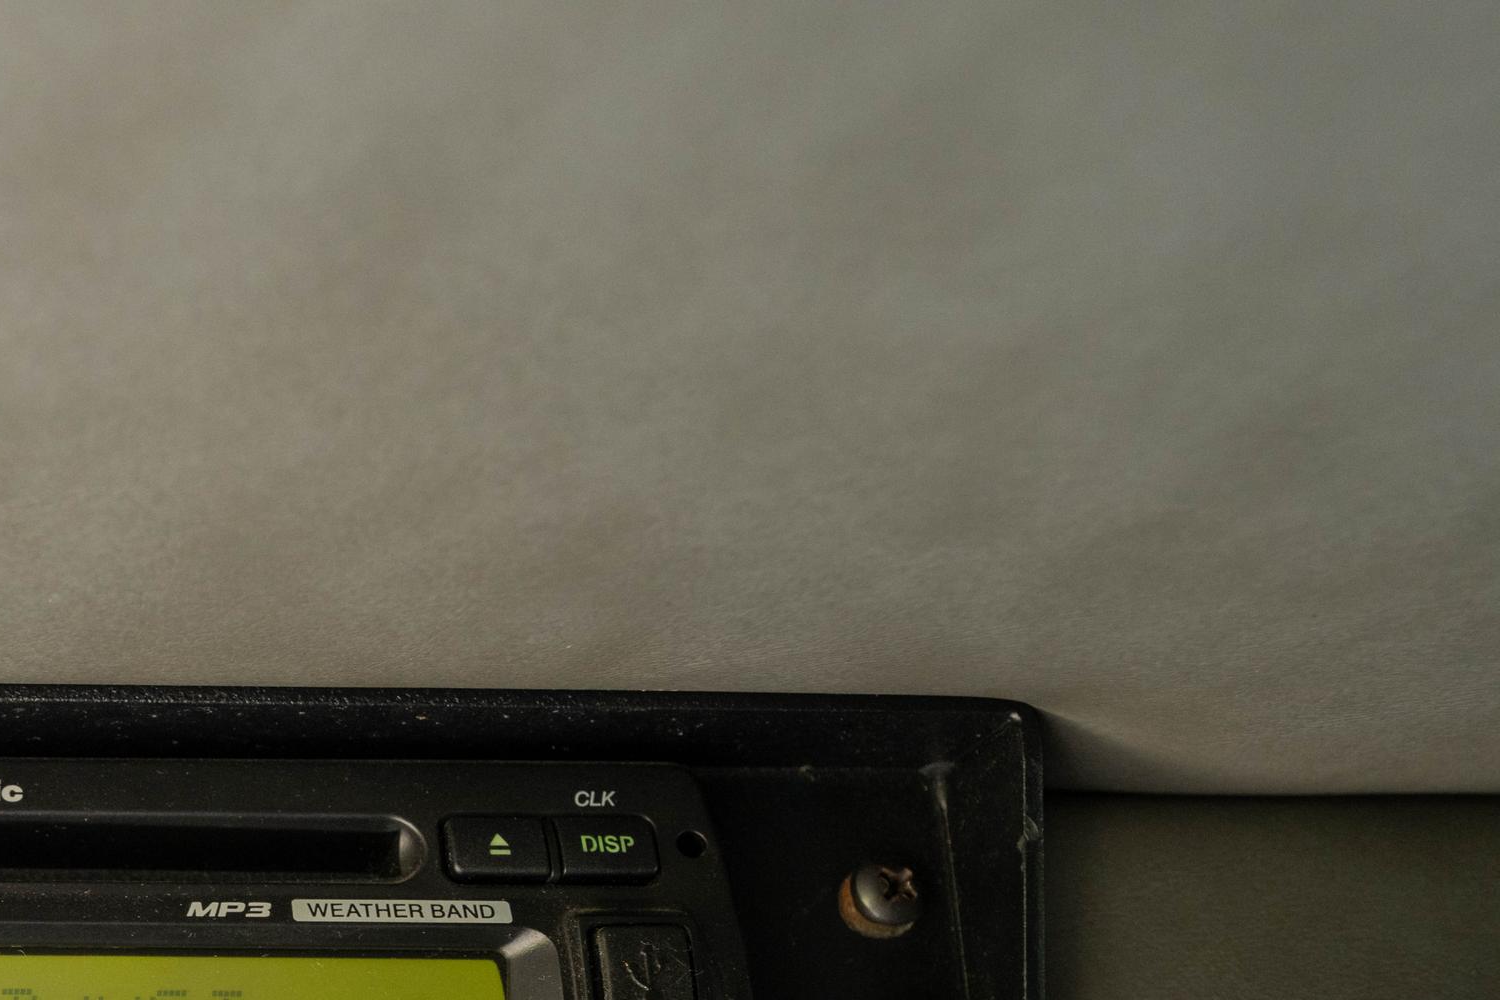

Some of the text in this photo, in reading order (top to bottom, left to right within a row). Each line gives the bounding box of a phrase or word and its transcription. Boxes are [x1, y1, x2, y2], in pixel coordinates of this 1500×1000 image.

[574, 790, 616, 807] CLK
[581, 834, 635, 855] DISP
[186, 901, 272, 918] MP3
[307, 902, 496, 919] WEATHER BAND
